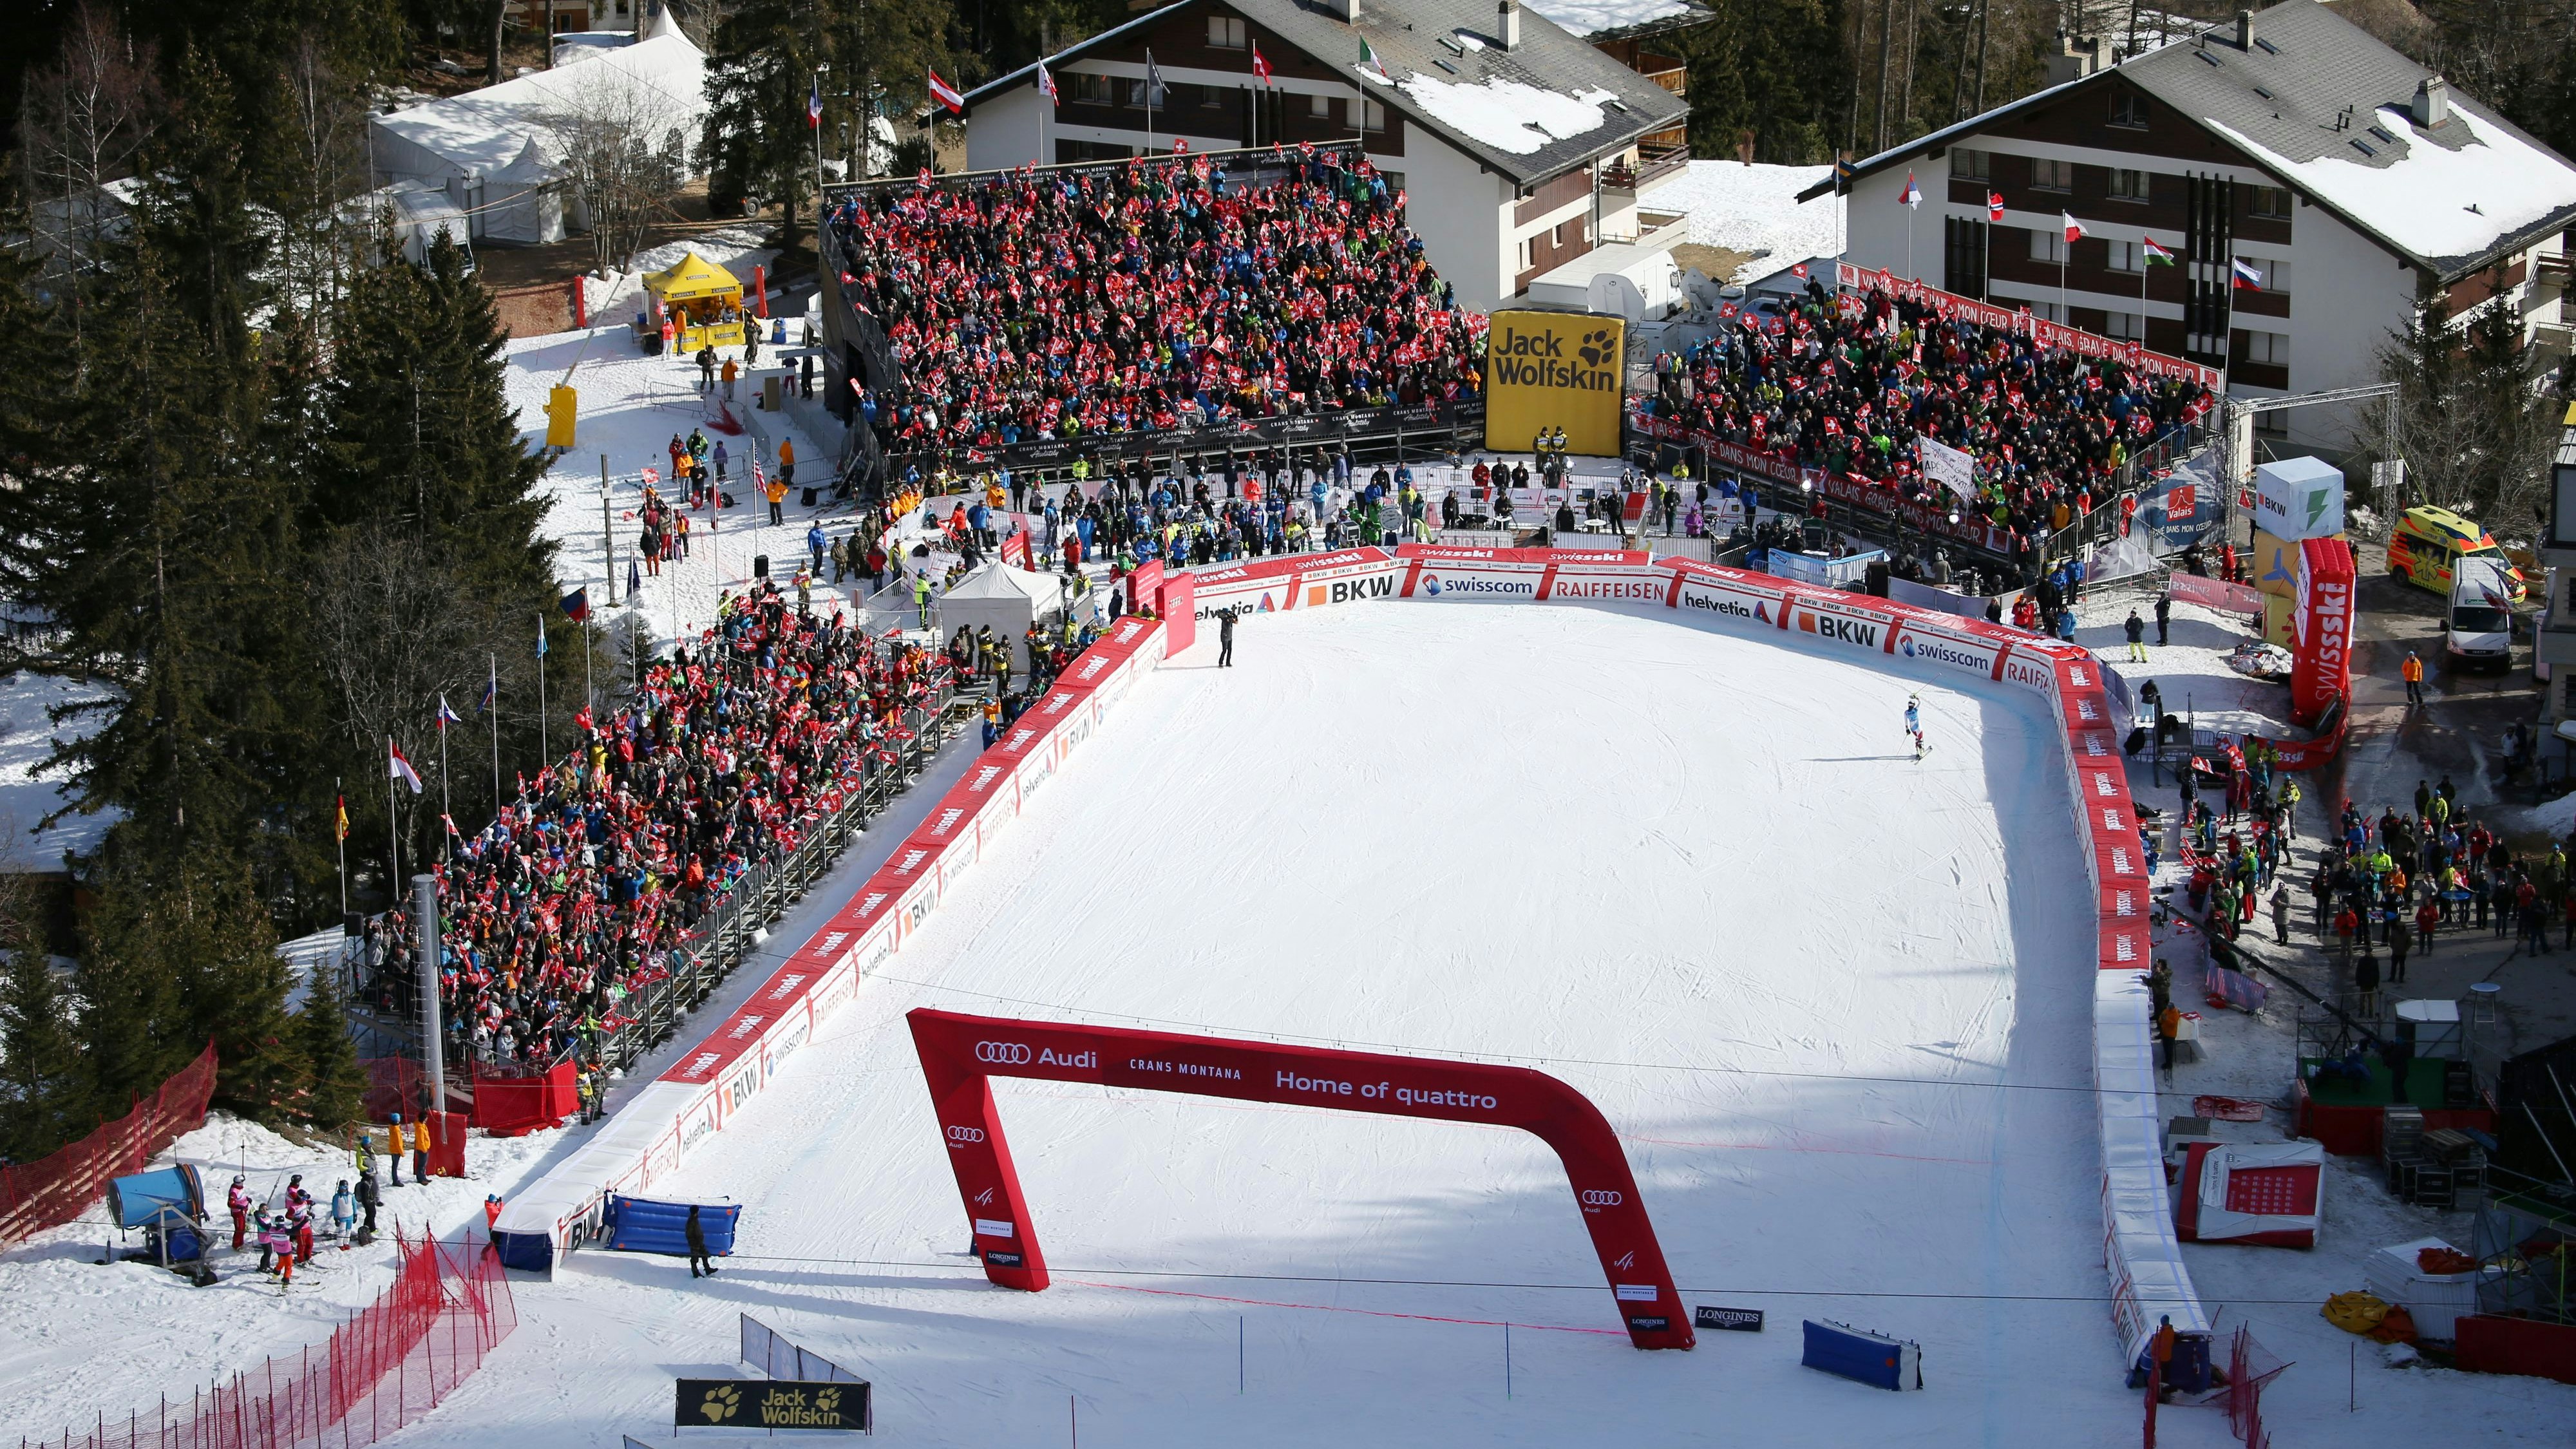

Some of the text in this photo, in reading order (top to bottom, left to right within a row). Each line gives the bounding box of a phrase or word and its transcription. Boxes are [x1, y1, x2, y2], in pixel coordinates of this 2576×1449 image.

[1957, 303, 1977, 322] MON
[1495, 327, 1564, 357] Jack
[1494, 357, 1615, 392] Wolfskin
[2141, 357, 2162, 376] MON
[1282, 424, 1309, 433] Absolutely
[1343, 419, 1370, 428] Absolutely
[1030, 450, 1059, 459] Absolutely
[1719, 442, 1743, 464] DANS
[1747, 453, 1766, 473] MON
[2168, 506, 2193, 520] Valais
[2265, 497, 2286, 517] BKW
[2166, 525, 2181, 535] DANS
[2181, 524, 2194, 533] MON
[1295, 552, 1364, 569] swissski
[1417, 549, 1494, 558] swissski
[1549, 552, 1624, 562] swissski
[1774, 553, 1787, 564] SPORT
[1193, 568, 1248, 584] issski
[1338, 567, 1352, 575] BKW
[1390, 559, 1405, 567] BKW
[1332, 574, 1393, 604] BKW
[1445, 576, 1532, 594] swisscom
[1557, 582, 1663, 601] RAIFFEISEN
[1195, 601, 1254, 621] elvtia
[1685, 591, 1750, 618] helvetia
[1804, 598, 1888, 621] BKW BKW BKW BKW
[1113, 621, 1144, 645] swissski
[1819, 616, 1876, 647] BKW
[2311, 582, 2346, 701] swissski
[1077, 655, 1110, 681] swissski
[1918, 643, 1989, 670] swisscom
[1042, 692, 1075, 715] swissski
[1003, 729, 1036, 752] swissski
[1068, 716, 1090, 753] BKW
[969, 765, 1004, 793] swissski
[2094, 772, 2118, 797] swissski
[931, 806, 964, 836] swissski
[981, 795, 1016, 848] RAIFFEISEN
[894, 849, 928, 876] swissski
[2111, 846, 2135, 874] swissski
[852, 893, 888, 919] swissski
[912, 889, 934, 930] BKW
[2116, 889, 2137, 916] swissski
[813, 931, 849, 958] swissski
[2116, 934, 2137, 961] swissski
[861, 945, 887, 982] helvetia
[768, 974, 806, 1001] swissski
[815, 975, 855, 1027] RAIFFEISEN
[727, 1014, 764, 1040] swissski
[775, 1024, 808, 1066] swisscom
[1037, 1047, 1097, 1068] Audi
[681, 1052, 722, 1079] swissski
[1130, 1058, 1242, 1081] CRANS MONTANA
[734, 1063, 757, 1110] BKW
[1276, 1070, 1497, 1110] Home of quattro
[682, 1116, 706, 1156] helvetia
[989, 1252, 1019, 1262] LONGINES
[1698, 1309, 1759, 1323] LONGINES
[761, 1388, 806, 1406] Jack
[761, 1406, 840, 1426] Wolfskin
